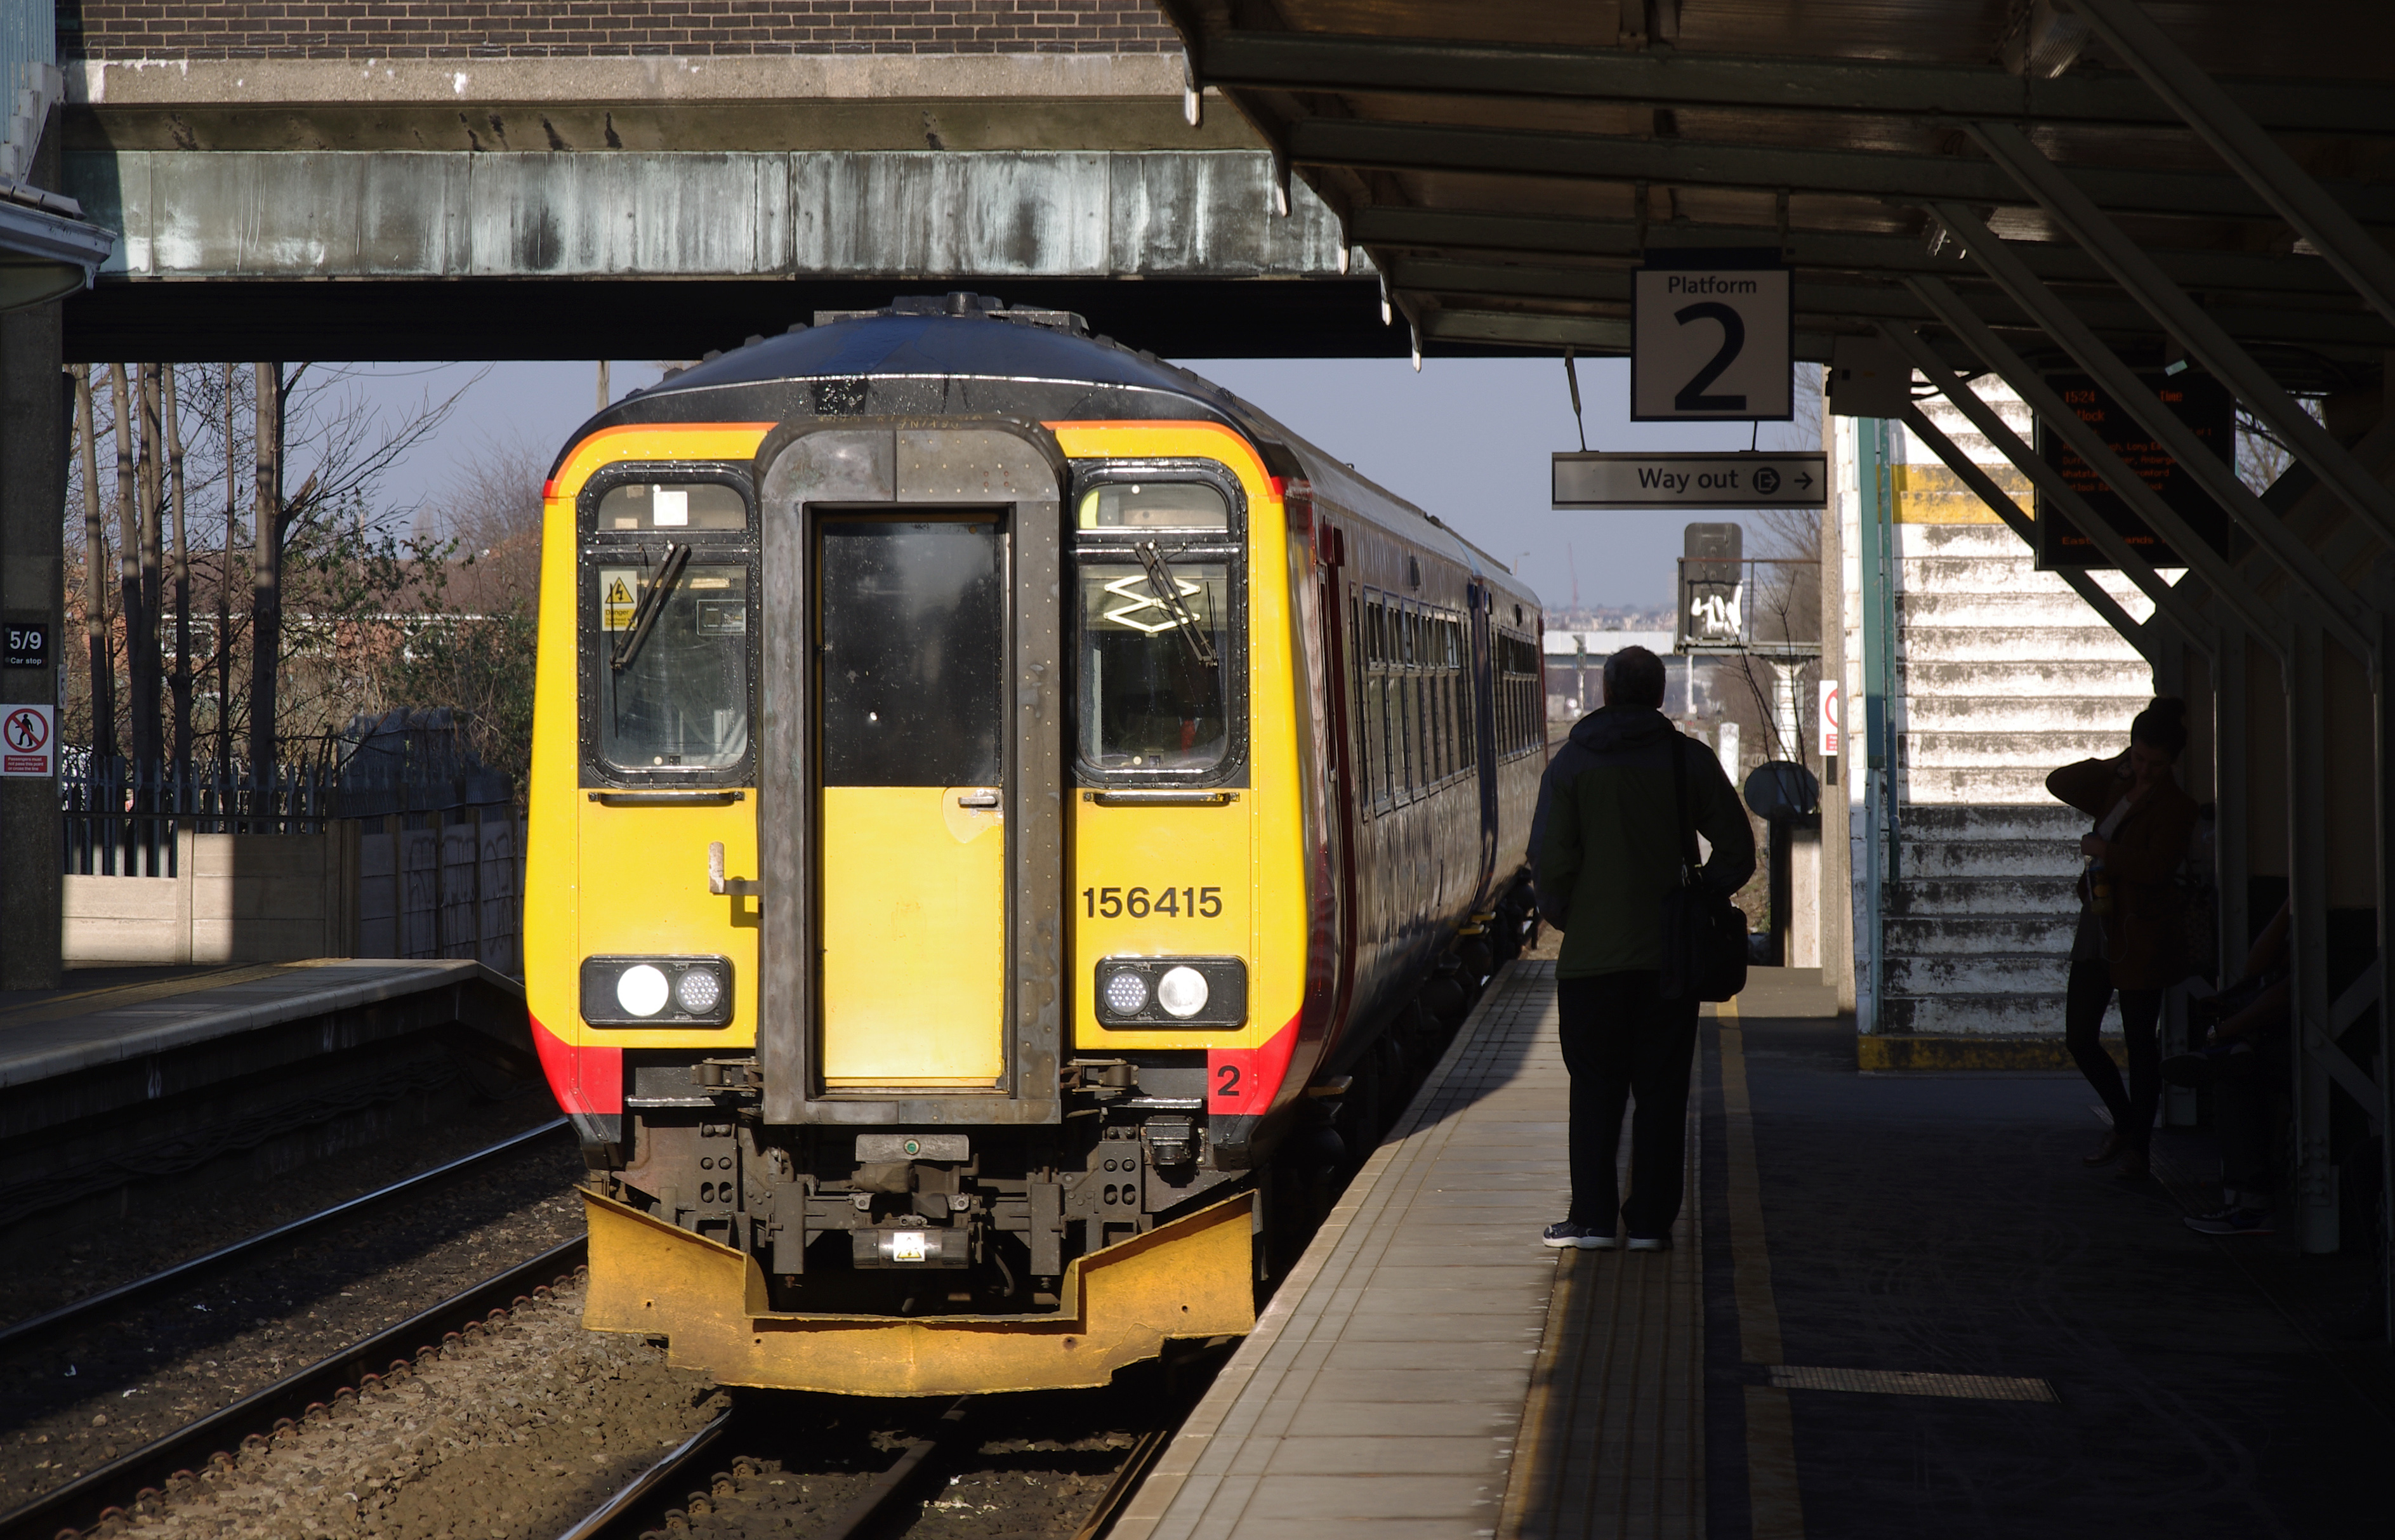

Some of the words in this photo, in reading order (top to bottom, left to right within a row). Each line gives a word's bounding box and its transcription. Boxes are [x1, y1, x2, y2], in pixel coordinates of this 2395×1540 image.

[1668, 276, 1757, 294] Platform
[1674, 301, 1746, 411] 2
[2076, 409, 2106, 421] tlock
[1638, 468, 1691, 494] Way
[1698, 470, 1739, 489] out
[10, 631, 42, 650] 5/9
[25, 657, 42, 666] stop
[1083, 887, 1222, 918] 156415
[1217, 1065, 1240, 1096] 2
